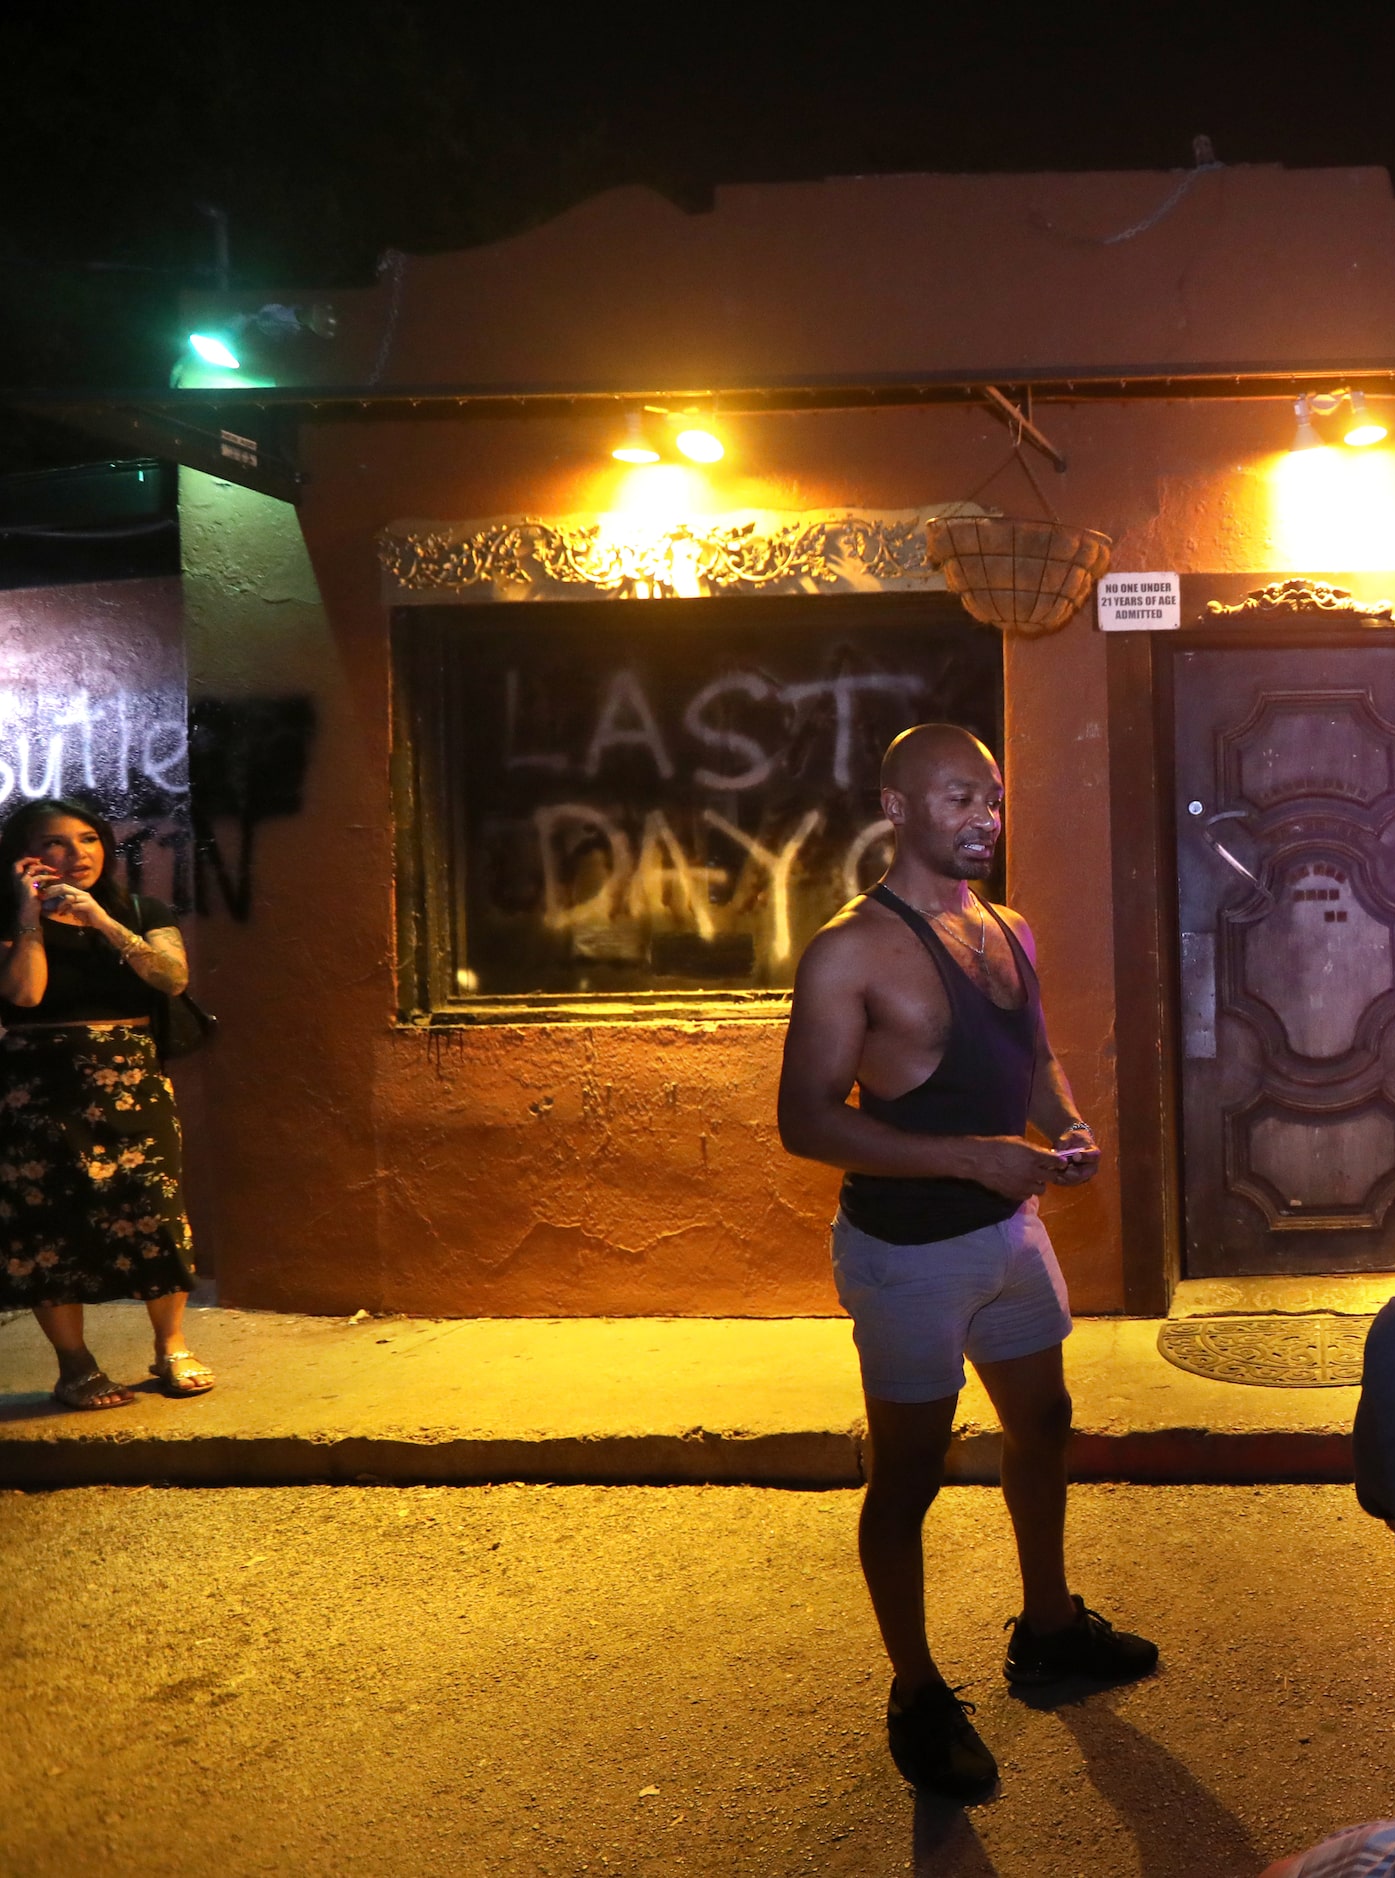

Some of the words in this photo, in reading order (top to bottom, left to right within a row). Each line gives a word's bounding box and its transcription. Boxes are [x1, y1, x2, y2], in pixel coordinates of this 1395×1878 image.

[1105, 583, 1118, 593] NO
[1120, 583, 1138, 593] ONE
[1140, 583, 1171, 592] UNDER
[1101, 597, 1112, 606] 21
[1114, 596, 1143, 606] YEARS
[1145, 596, 1157, 605] OF
[1158, 596, 1176, 605] AGE
[1115, 610, 1163, 619] ADMITTED
[504, 669, 926, 791] LAST
